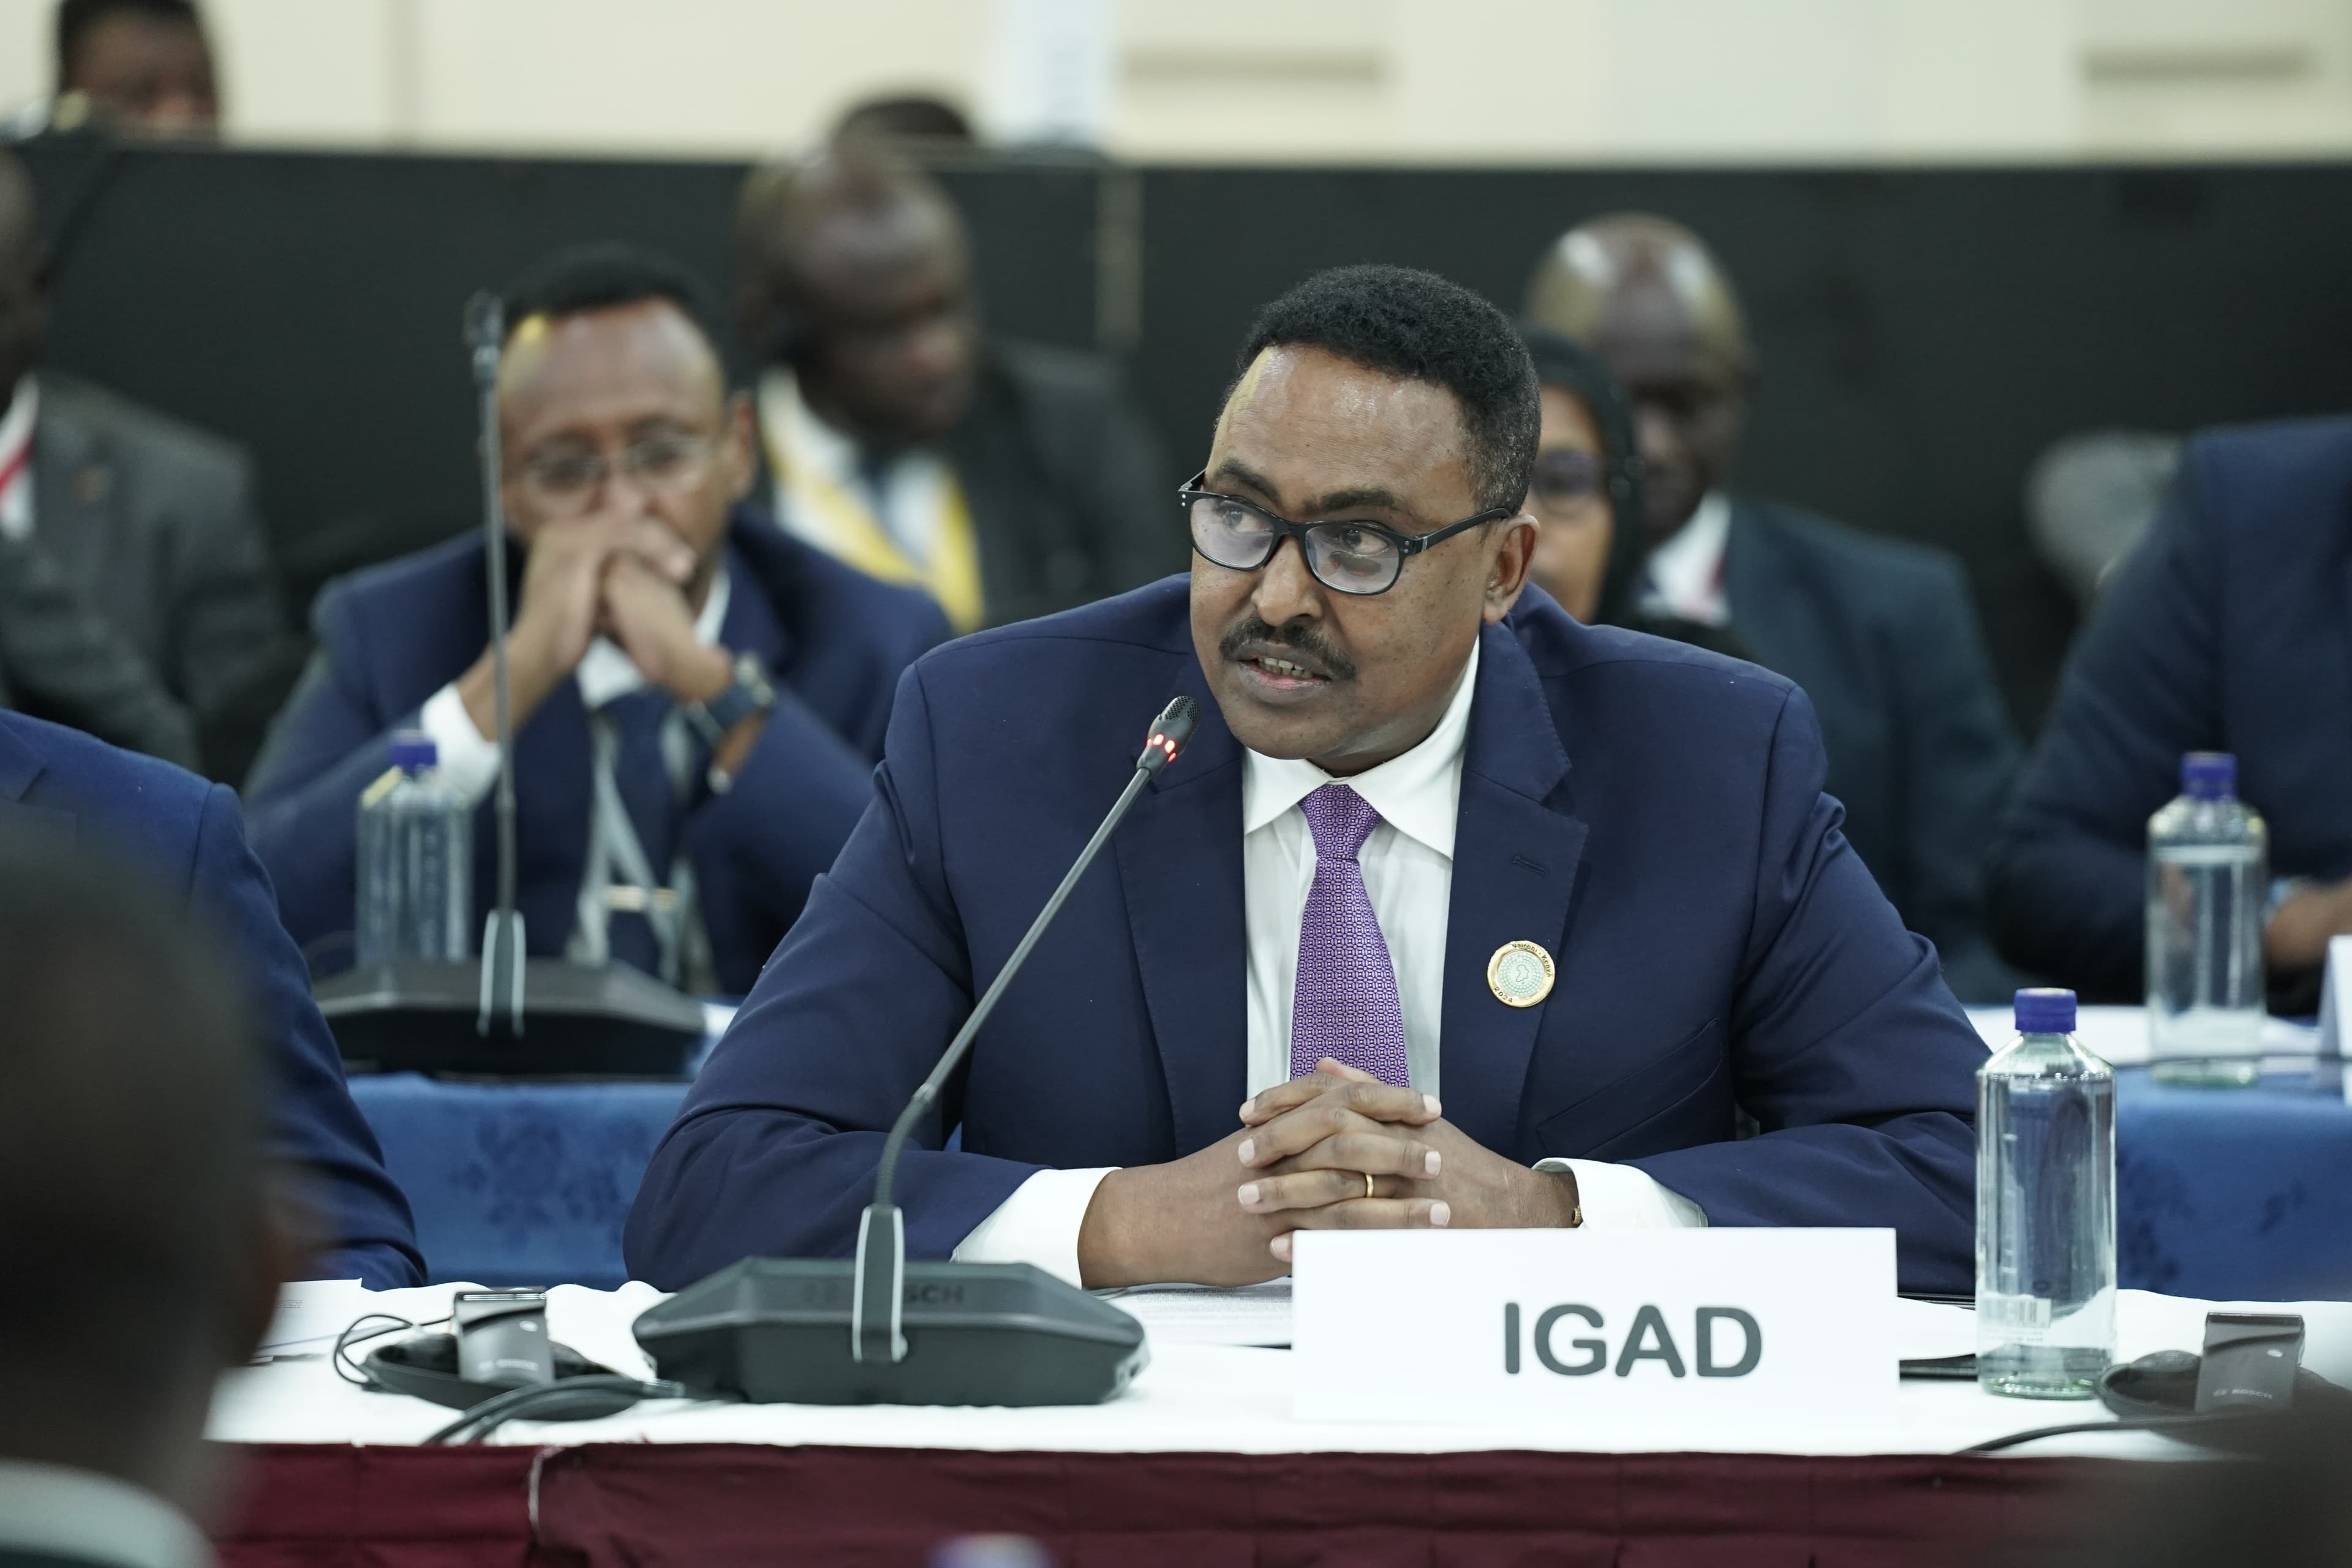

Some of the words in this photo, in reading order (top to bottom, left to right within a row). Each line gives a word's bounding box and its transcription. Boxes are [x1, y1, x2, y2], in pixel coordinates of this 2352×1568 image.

[1512, 943, 1538, 952] Nairobi
[1541, 955, 1551, 977] Kenya
[1494, 987, 1513, 1003] 2024
[903, 1284, 964, 1305] SCH
[1505, 1302, 1762, 1378] IGAD
[2231, 1389, 2273, 1400] BOSCH
